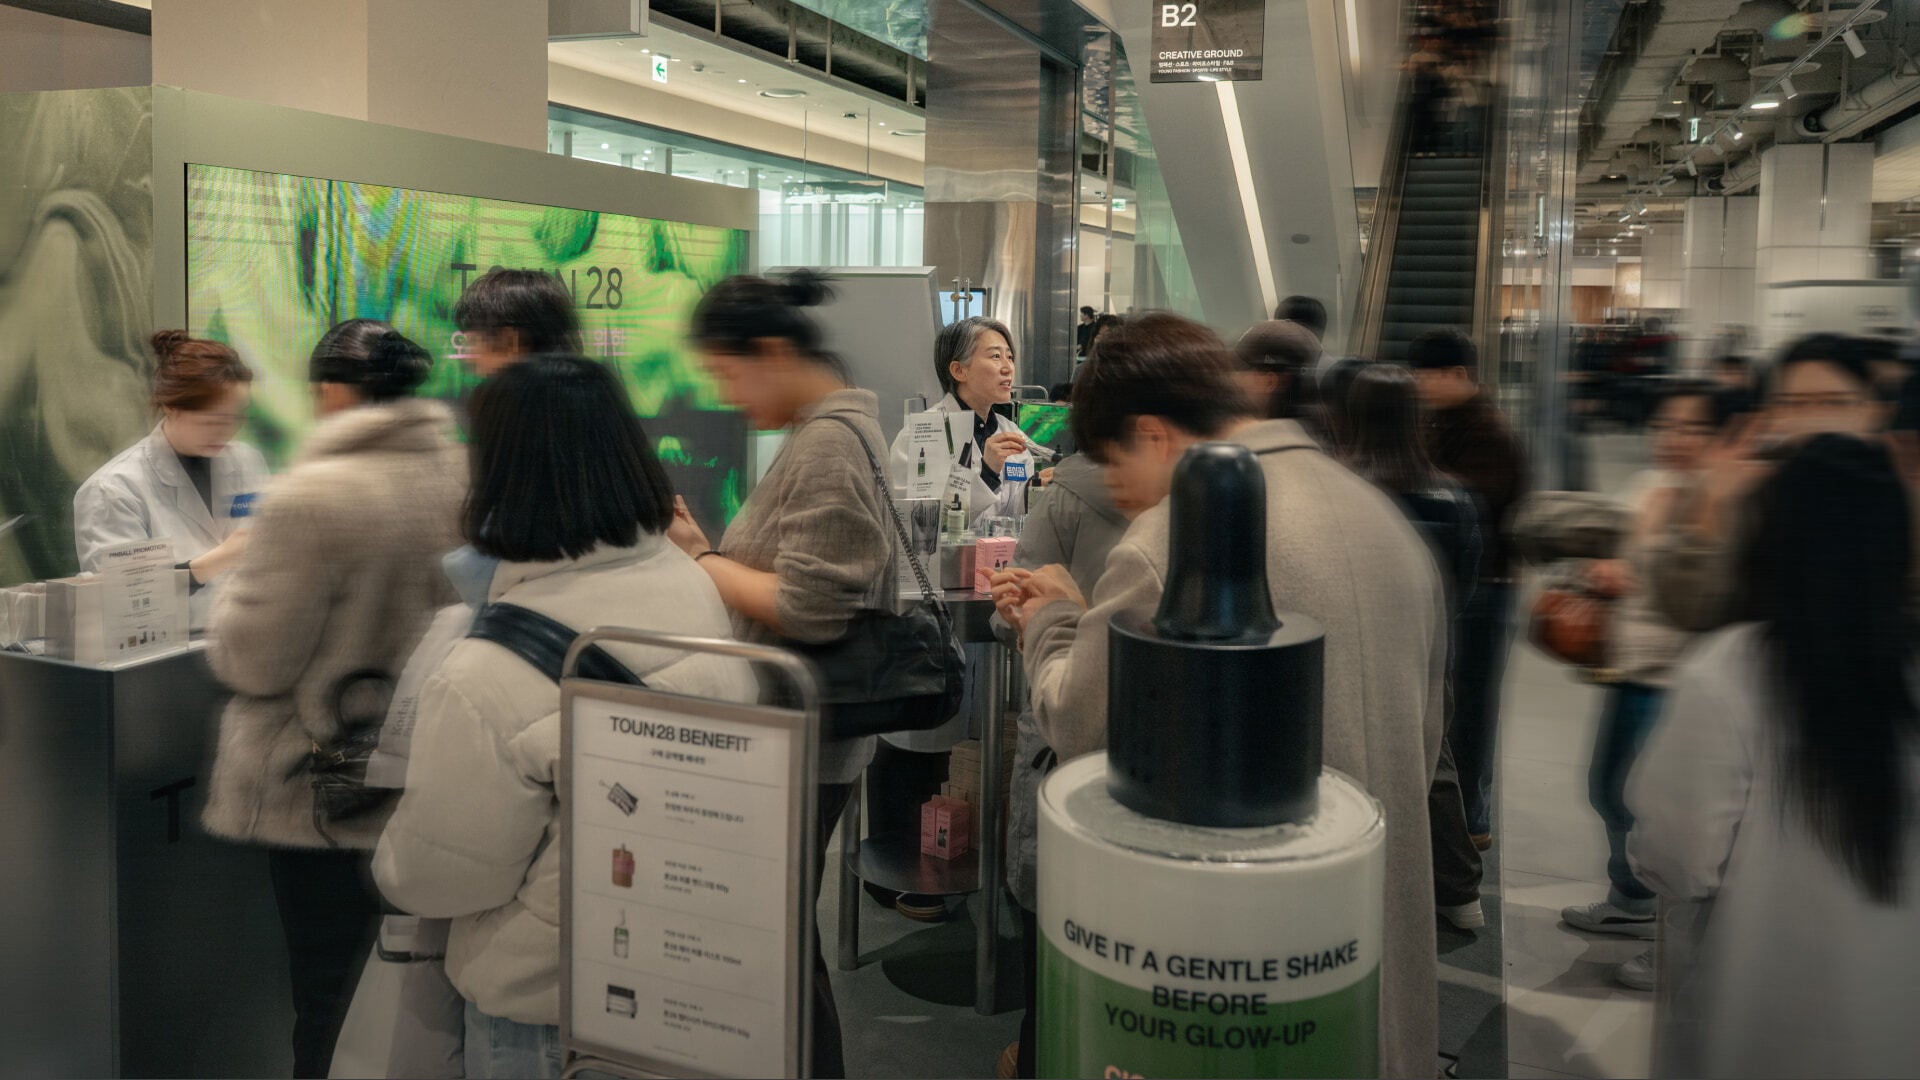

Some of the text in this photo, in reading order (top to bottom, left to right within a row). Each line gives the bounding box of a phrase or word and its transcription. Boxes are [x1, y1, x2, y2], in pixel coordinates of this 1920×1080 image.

[1162, 3, 1197, 27] B2
[1159, 49, 1243, 60] CREATIVE GROUND
[609, 715, 752, 753] TOUN28 BENEFIT
[1064, 918, 1359, 982] GIVE IT A GENTLE SHAKE
[1152, 985, 1268, 1015] BEFORE
[1104, 1002, 1317, 1049] YOUR GLOW-UP
